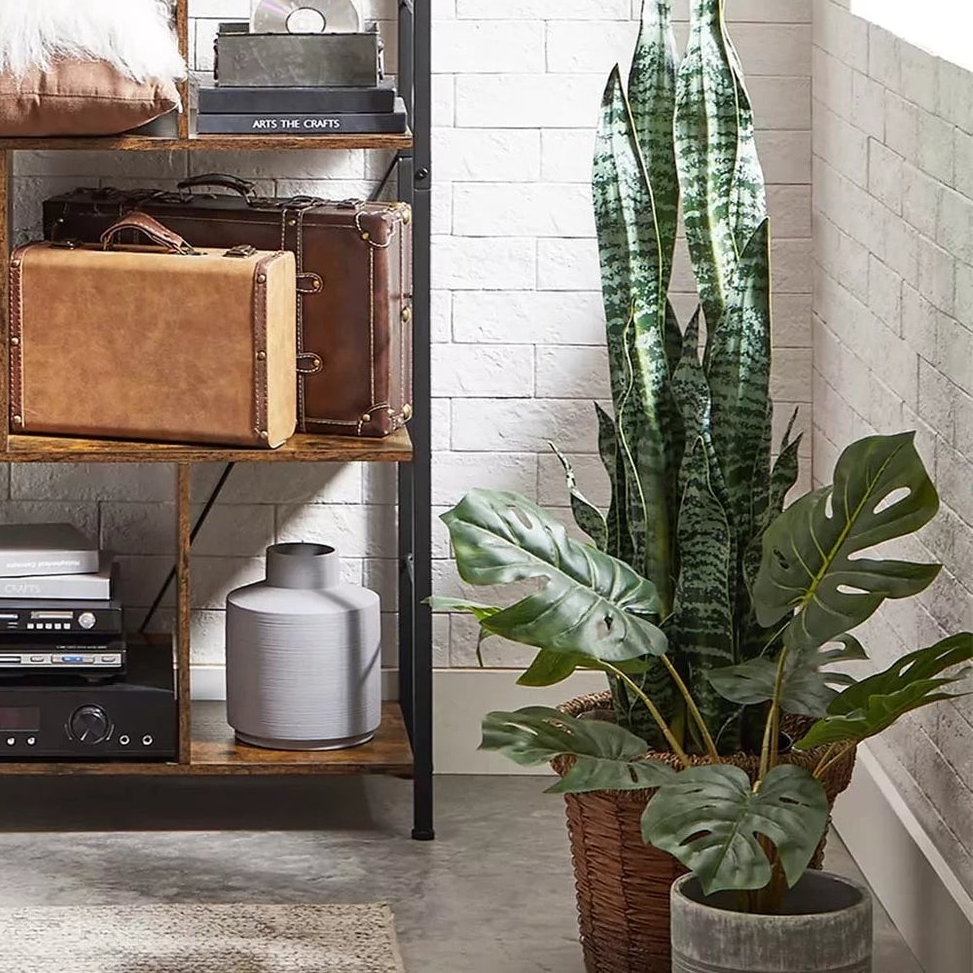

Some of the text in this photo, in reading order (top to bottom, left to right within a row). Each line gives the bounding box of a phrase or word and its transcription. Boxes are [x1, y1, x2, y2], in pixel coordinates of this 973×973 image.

[252, 119, 340, 128] ARTS THE CRAFTS
